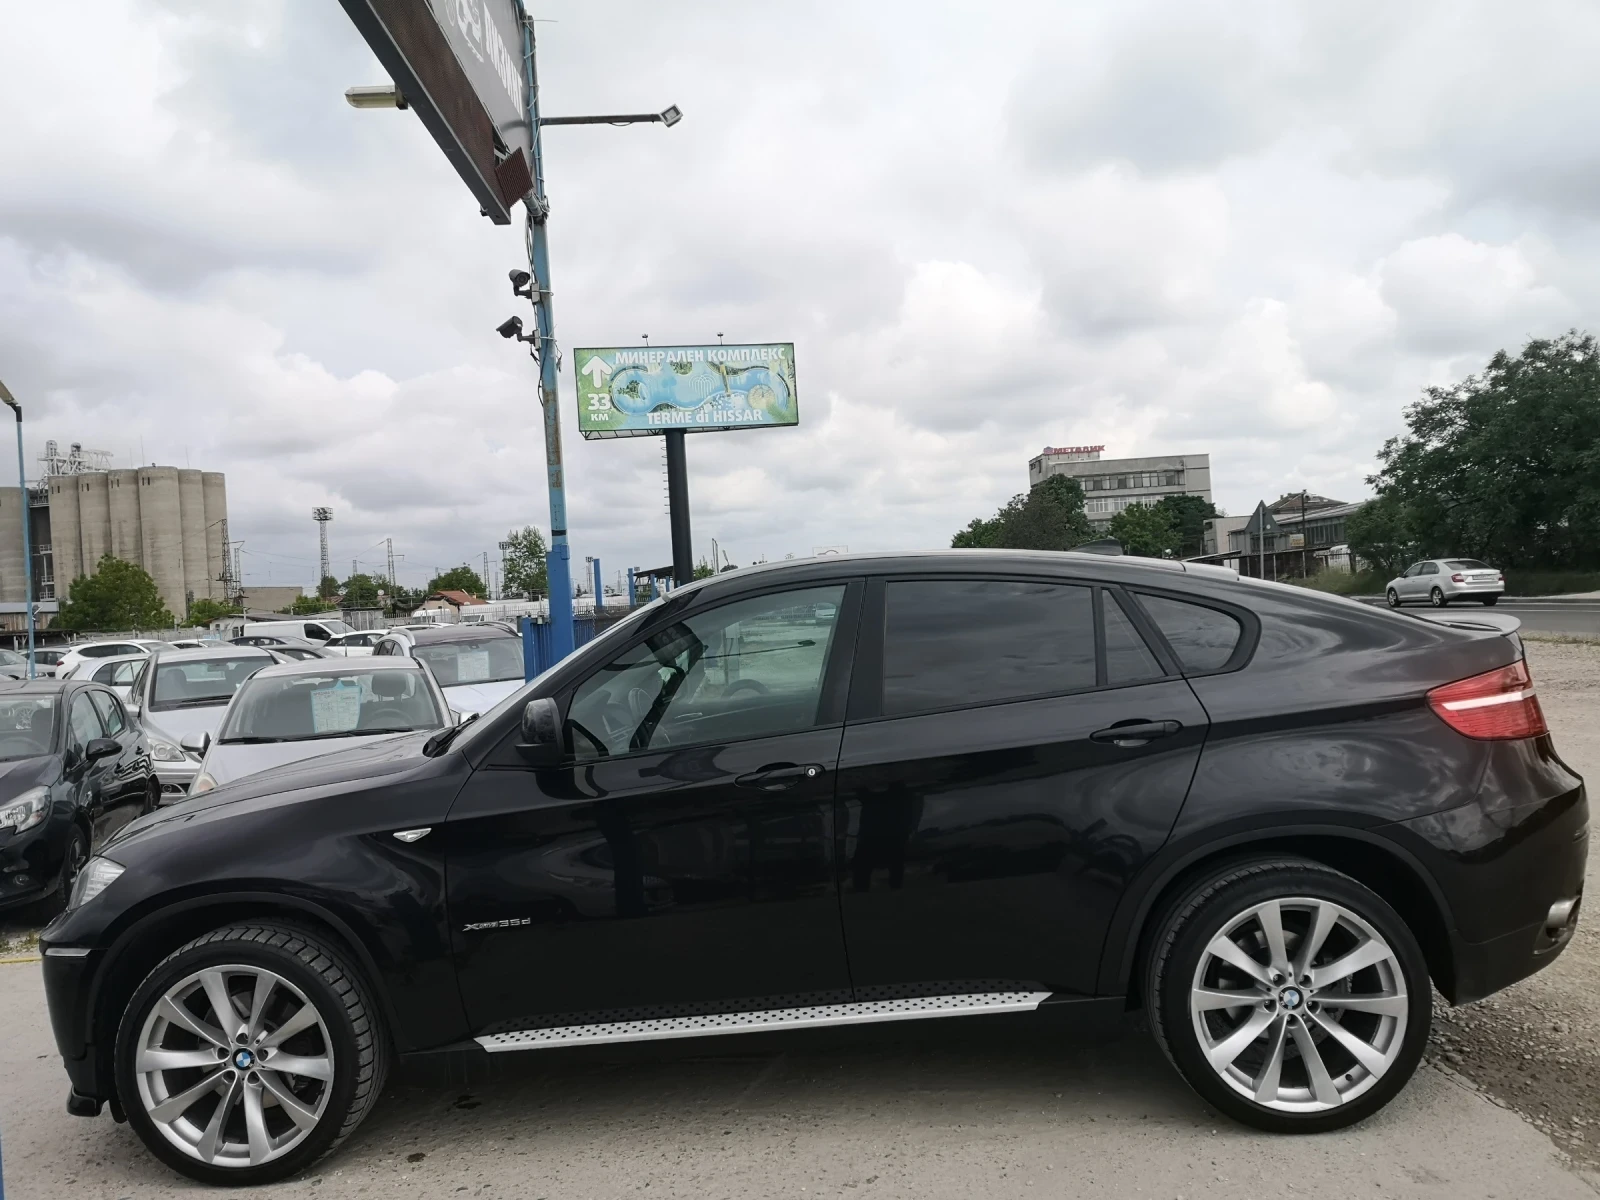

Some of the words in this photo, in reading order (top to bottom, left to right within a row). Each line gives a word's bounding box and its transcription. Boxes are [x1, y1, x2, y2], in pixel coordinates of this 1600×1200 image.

[615, 349, 704, 364] МИНЕРАЛЕН
[707, 347, 786, 362] КОМПЛЕКС
[587, 393, 611, 411] 33
[646, 410, 692, 425] TERME
[696, 410, 709, 423] di
[713, 408, 763, 423] HISSAR
